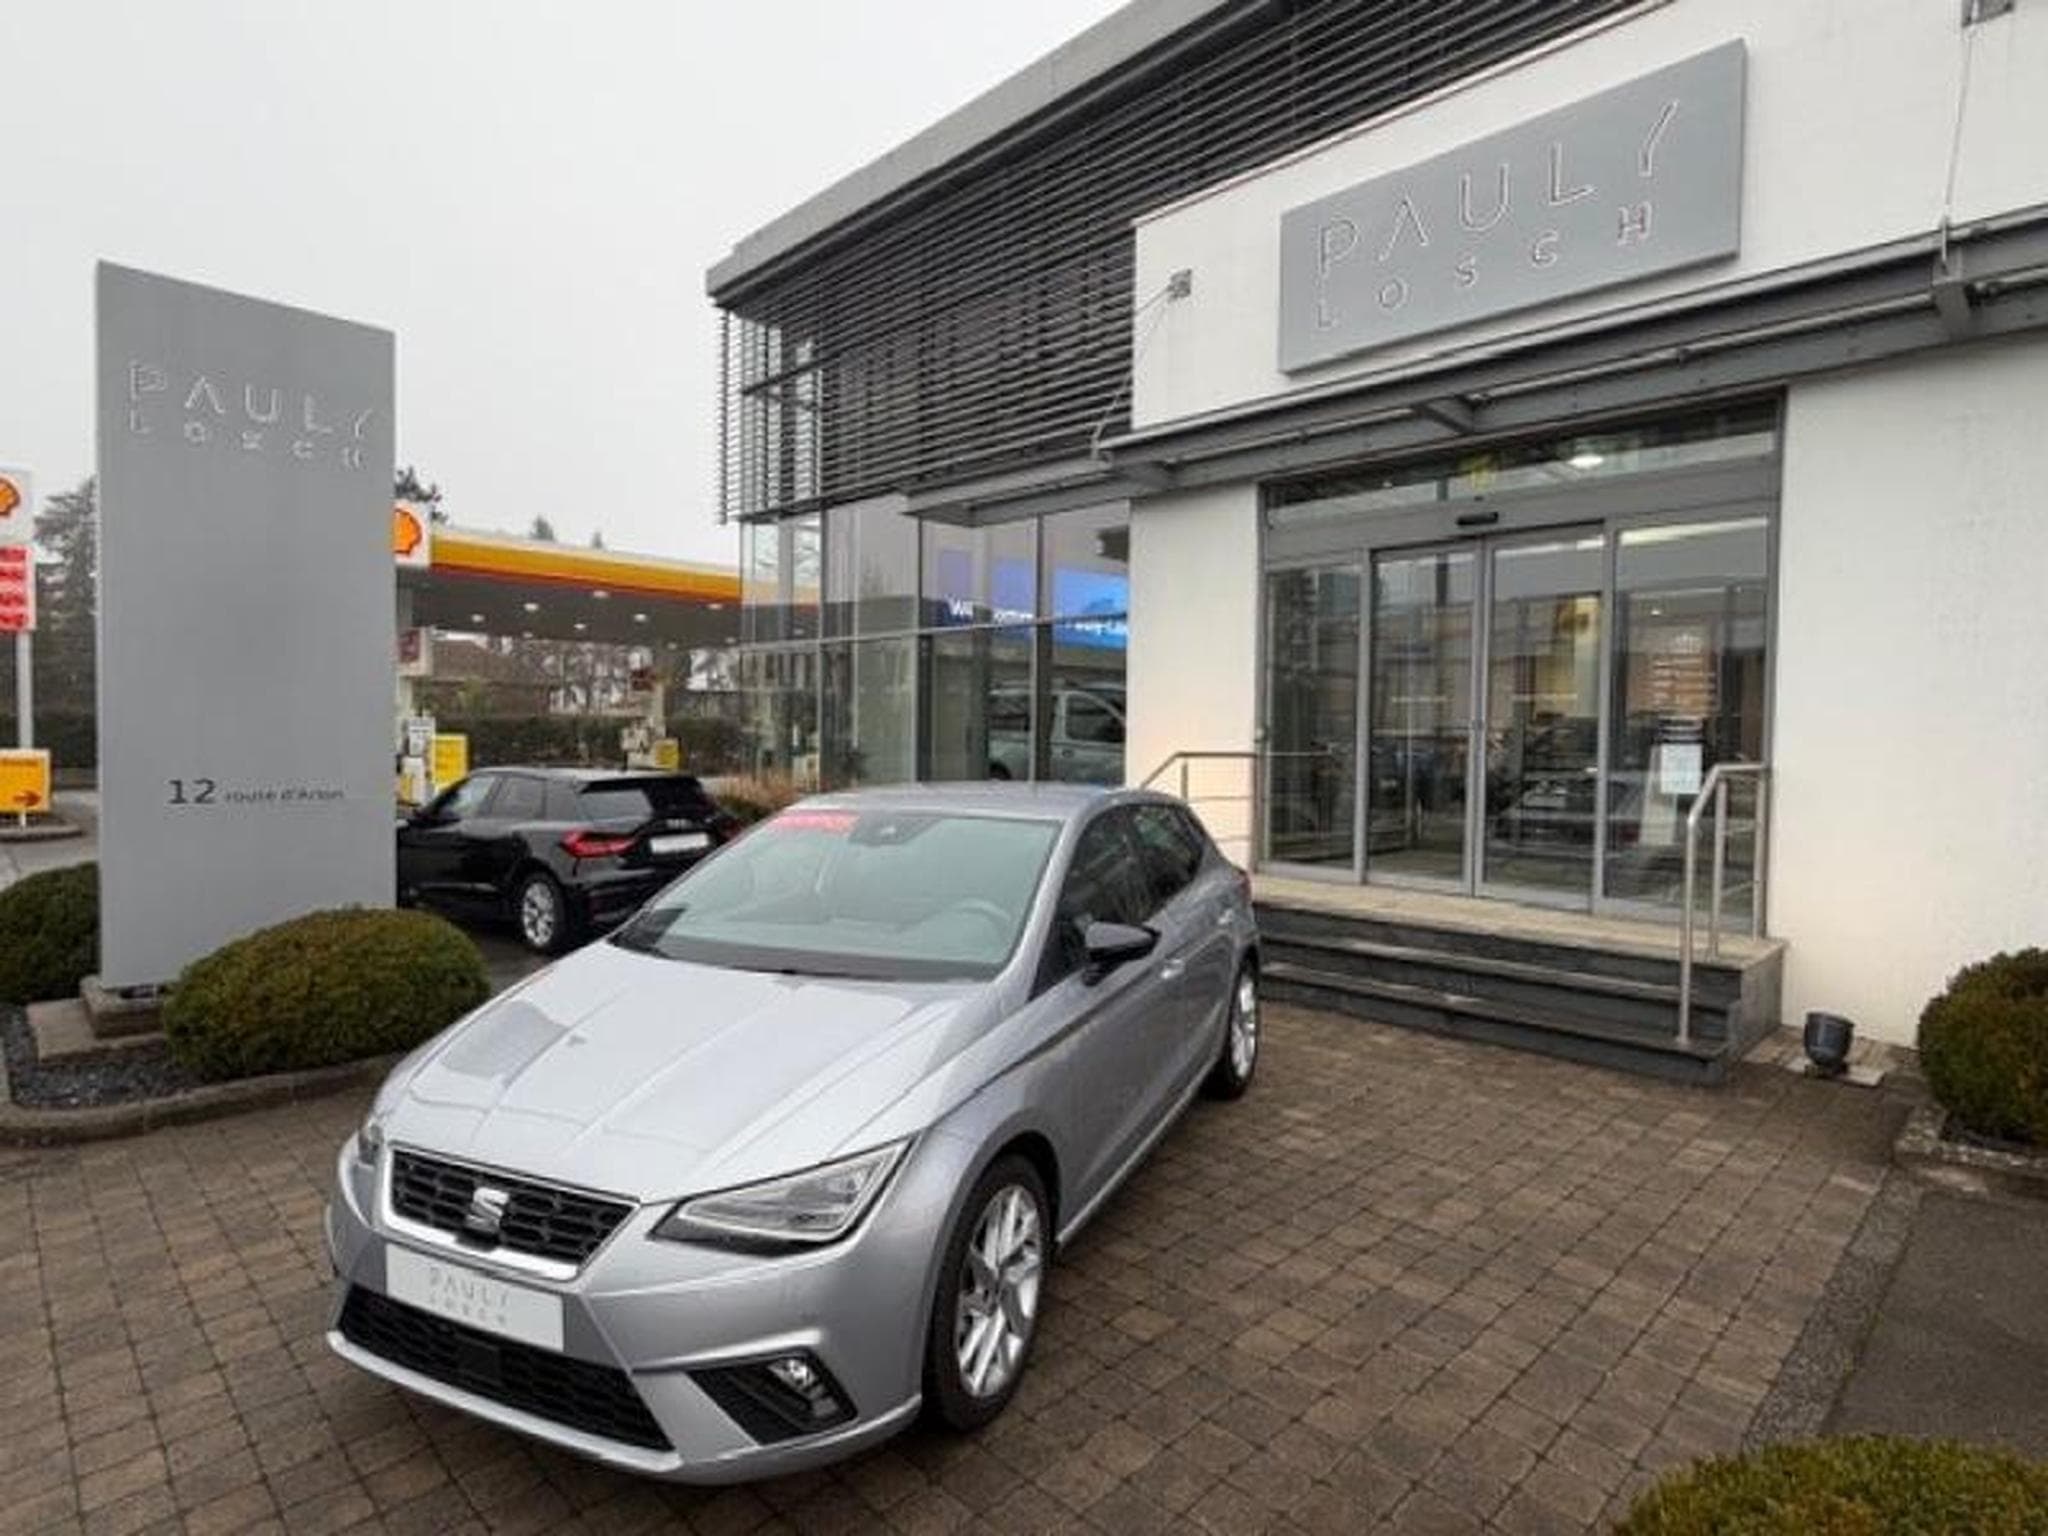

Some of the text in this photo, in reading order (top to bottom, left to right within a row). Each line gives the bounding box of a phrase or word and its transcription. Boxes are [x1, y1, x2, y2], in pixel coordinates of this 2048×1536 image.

[1316, 100, 1679, 277] PAULY
[1316, 200, 1653, 330] LOSCH
[129, 363, 374, 439] PAULY
[167, 779, 216, 805] 12
